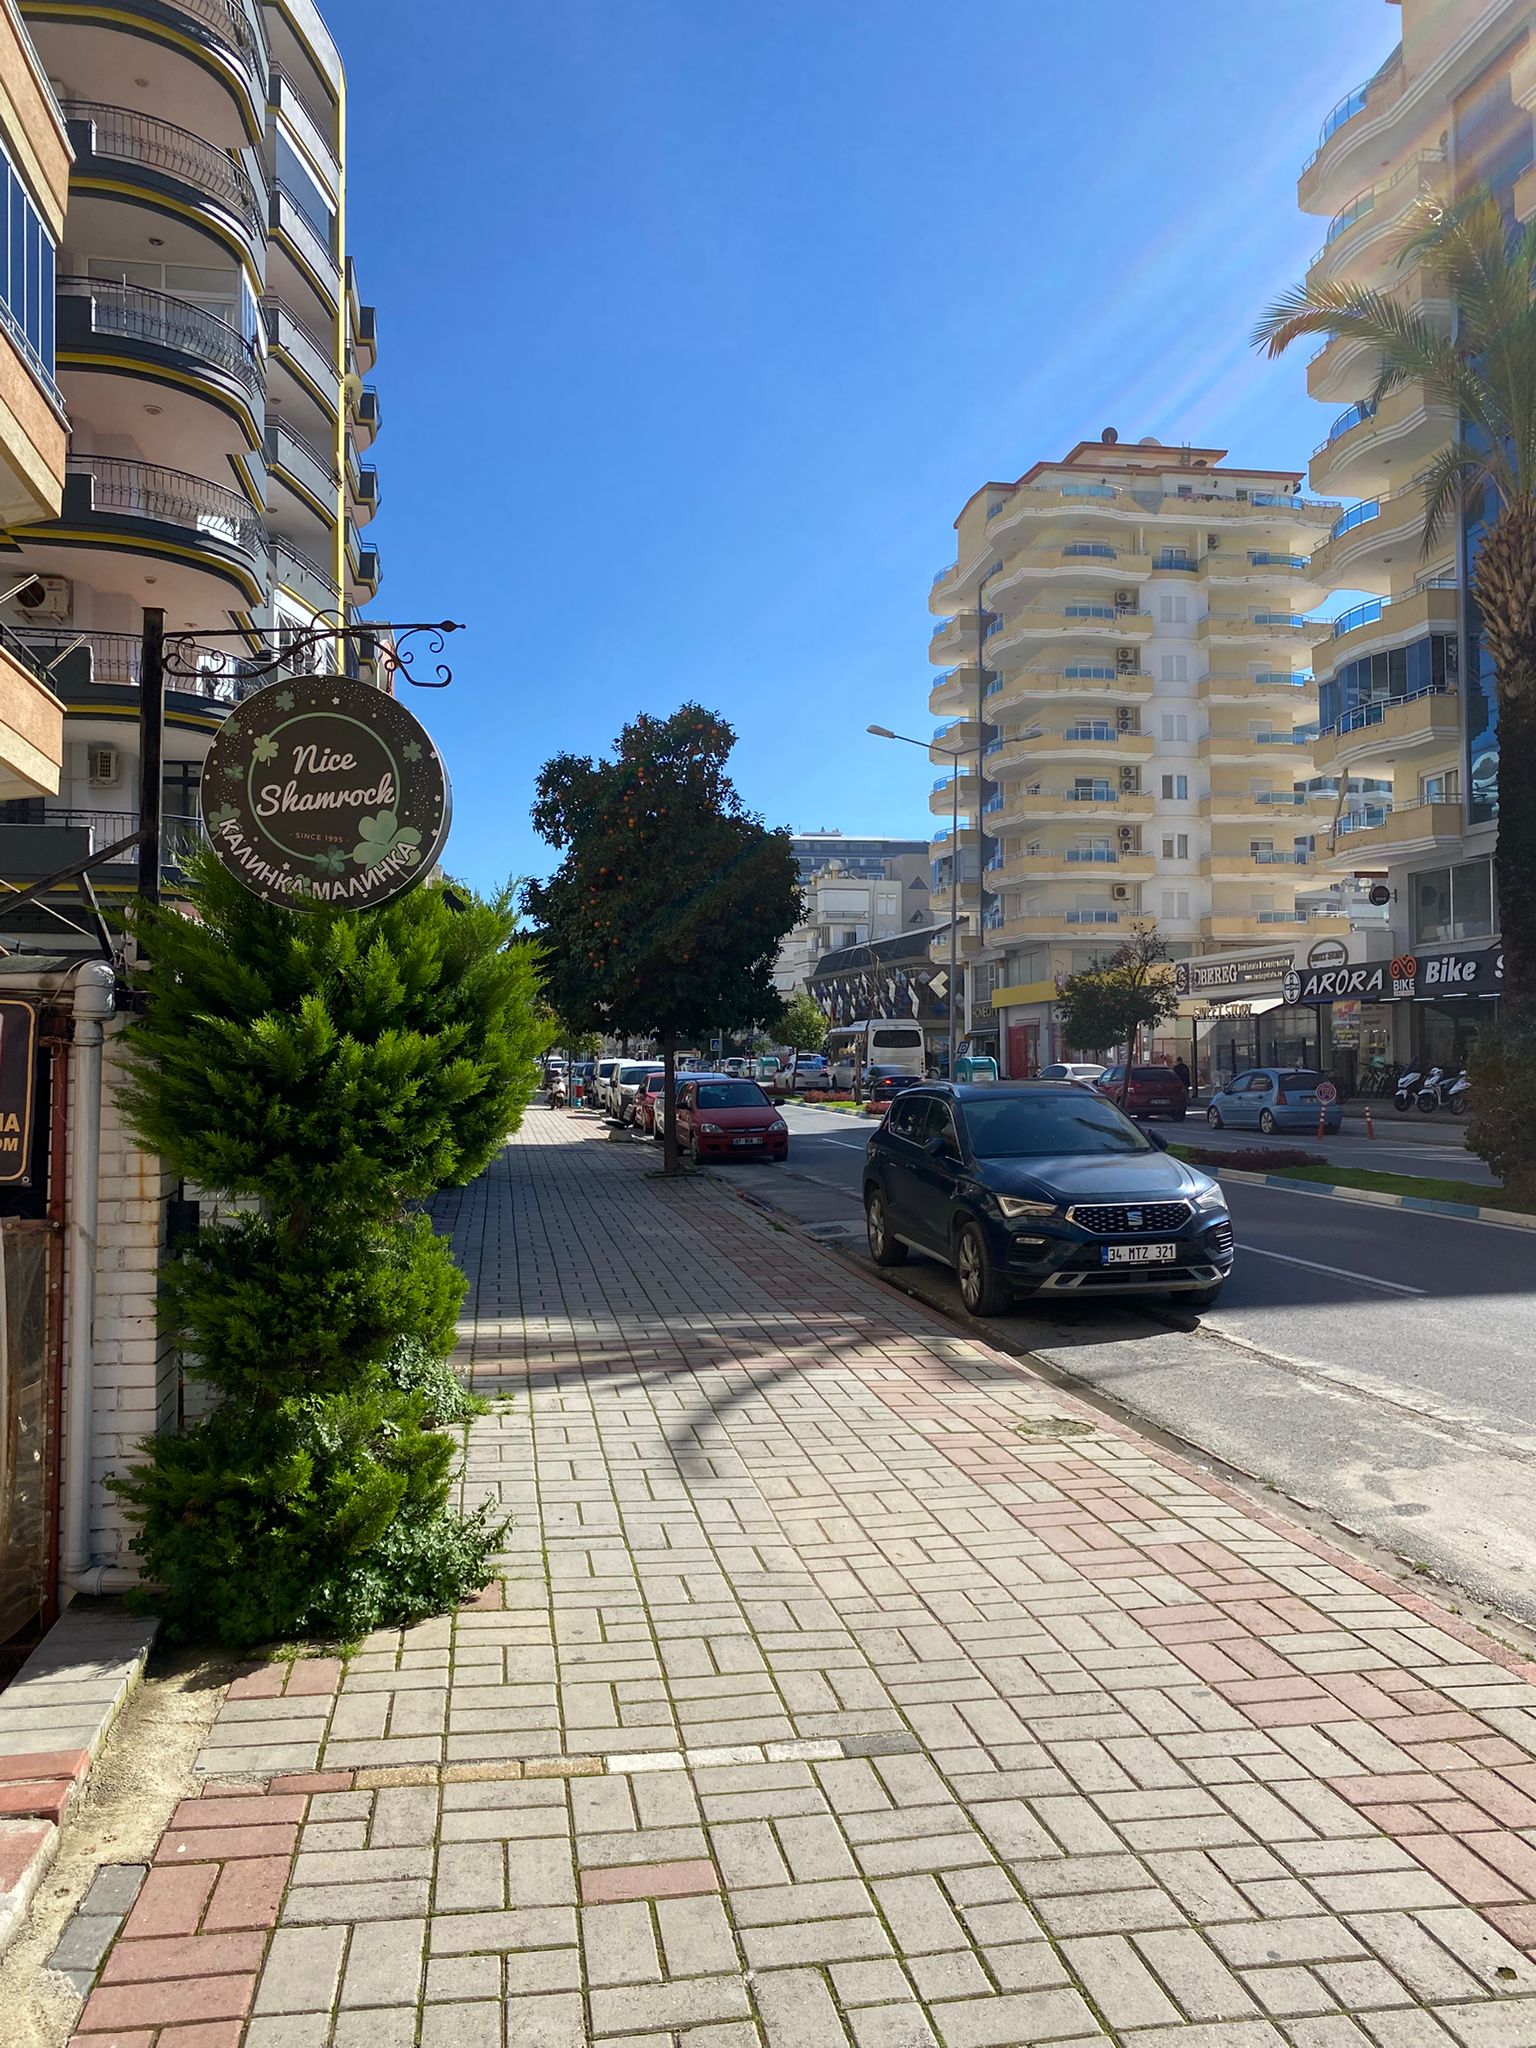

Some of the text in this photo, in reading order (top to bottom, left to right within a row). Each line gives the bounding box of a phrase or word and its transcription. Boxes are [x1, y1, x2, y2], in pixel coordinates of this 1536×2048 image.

[292, 744, 357, 775] Nice
[256, 772, 395, 817] Shamrock
[295, 831, 344, 844] SINCE 1995
[219, 818, 417, 900] КАЛИНКА МАЛИНКА
[1303, 968, 1383, 996] ARORA
[1425, 956, 1477, 984] Bike
[1393, 978, 1415, 991] BIKE
[1109, 1245, 1174, 1261] 34 MTZ 321
